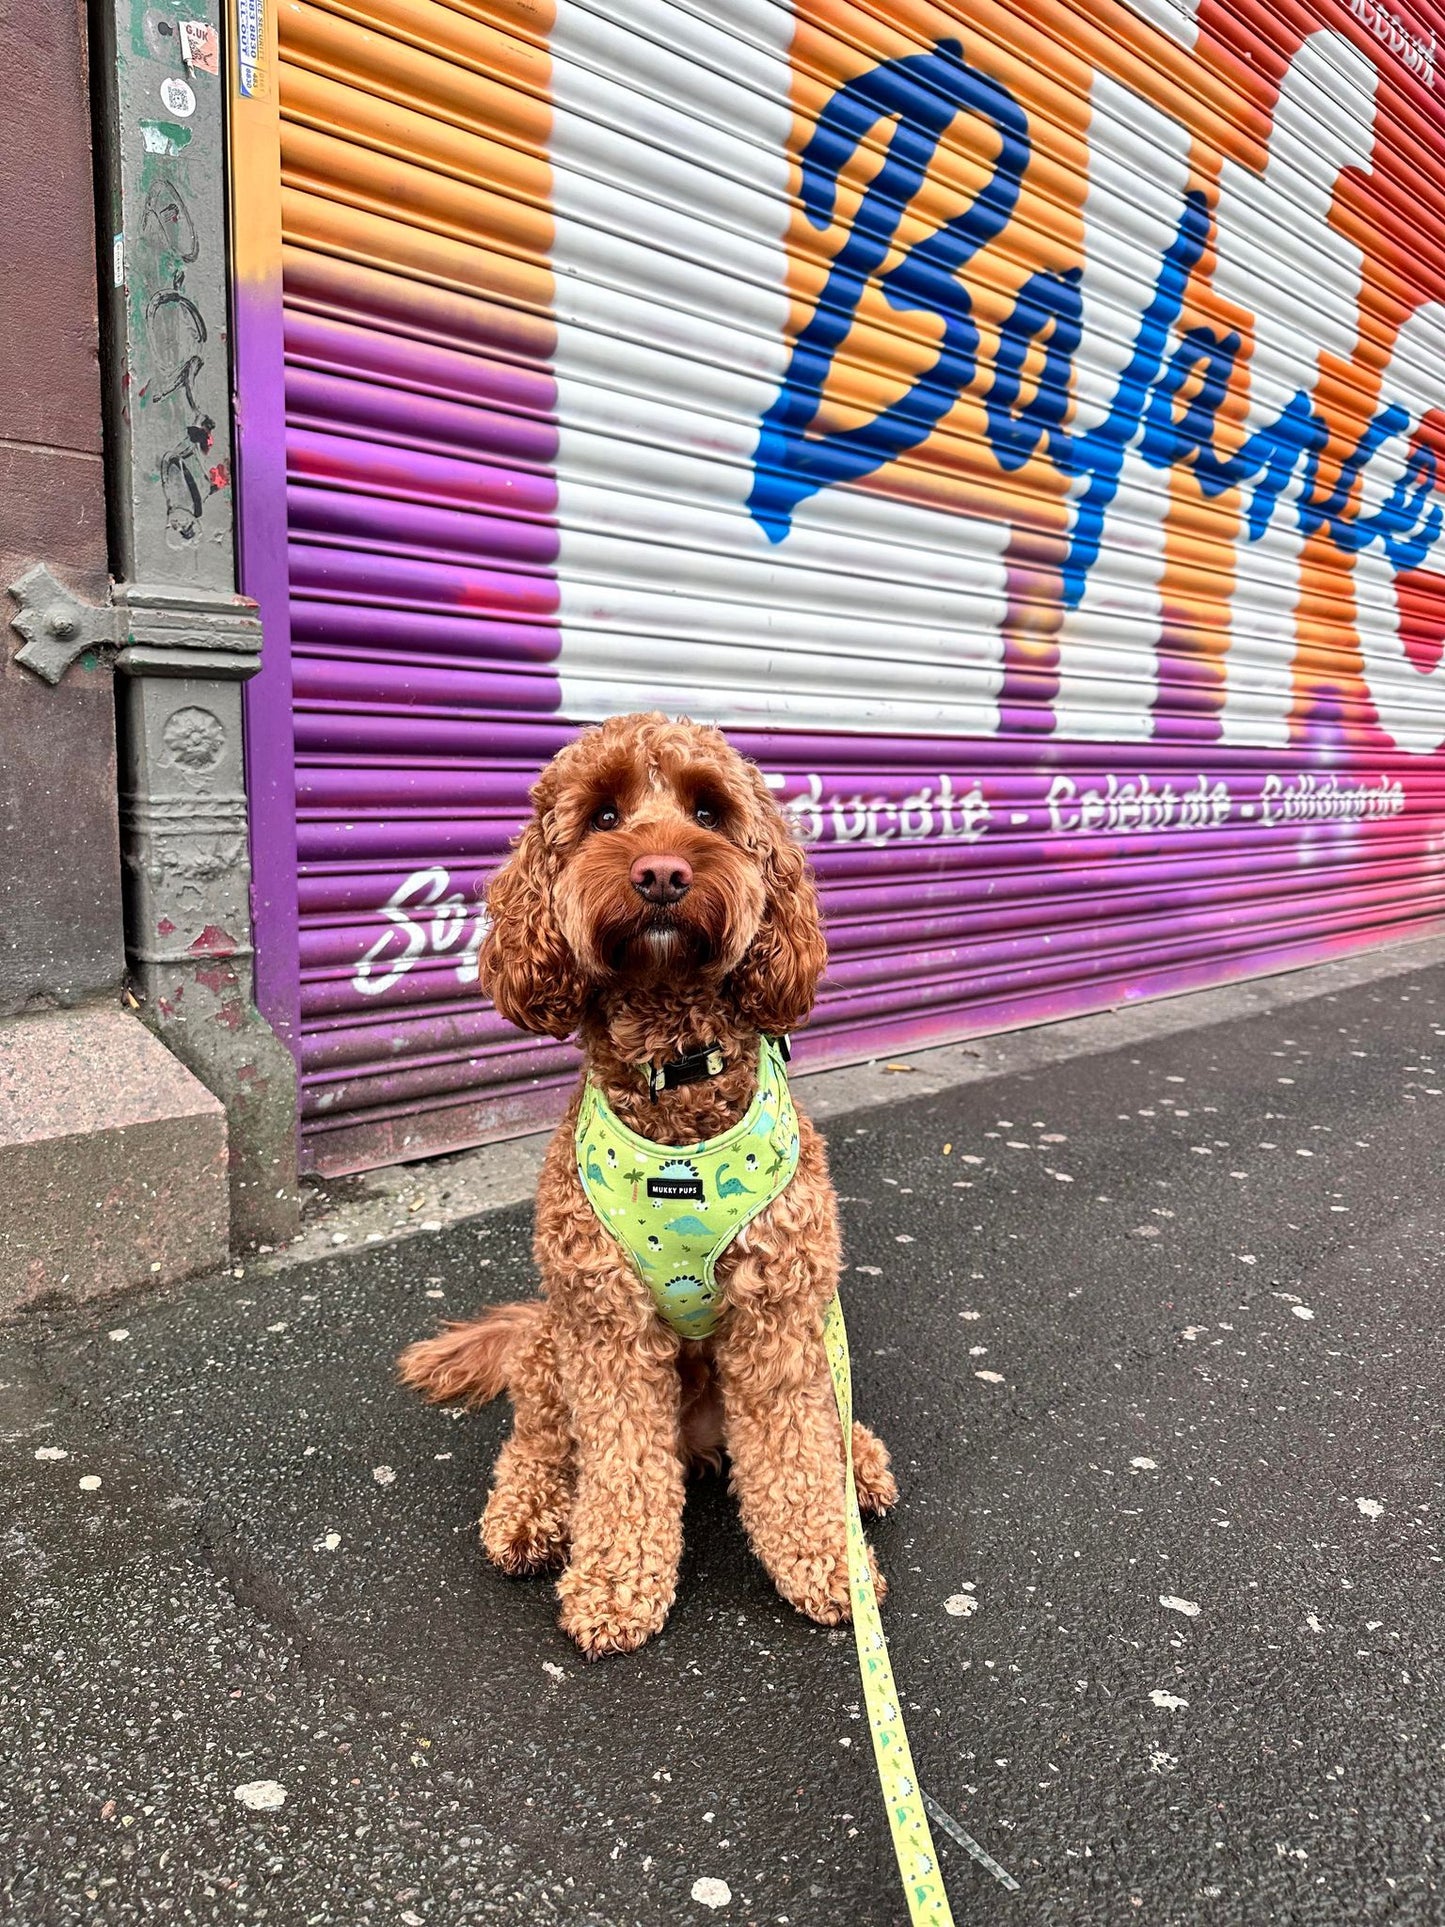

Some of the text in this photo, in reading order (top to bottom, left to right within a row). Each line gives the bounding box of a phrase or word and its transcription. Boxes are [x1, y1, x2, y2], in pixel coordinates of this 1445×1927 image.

[249, 25, 257, 58] 8830
[750, 36, 1445, 610] Balance
[764, 773, 993, 846] ducate
[1045, 774, 1232, 832] Celebrate
[1258, 774, 1405, 826] Collaborate
[652, 1186, 677, 1194] MUKKY
